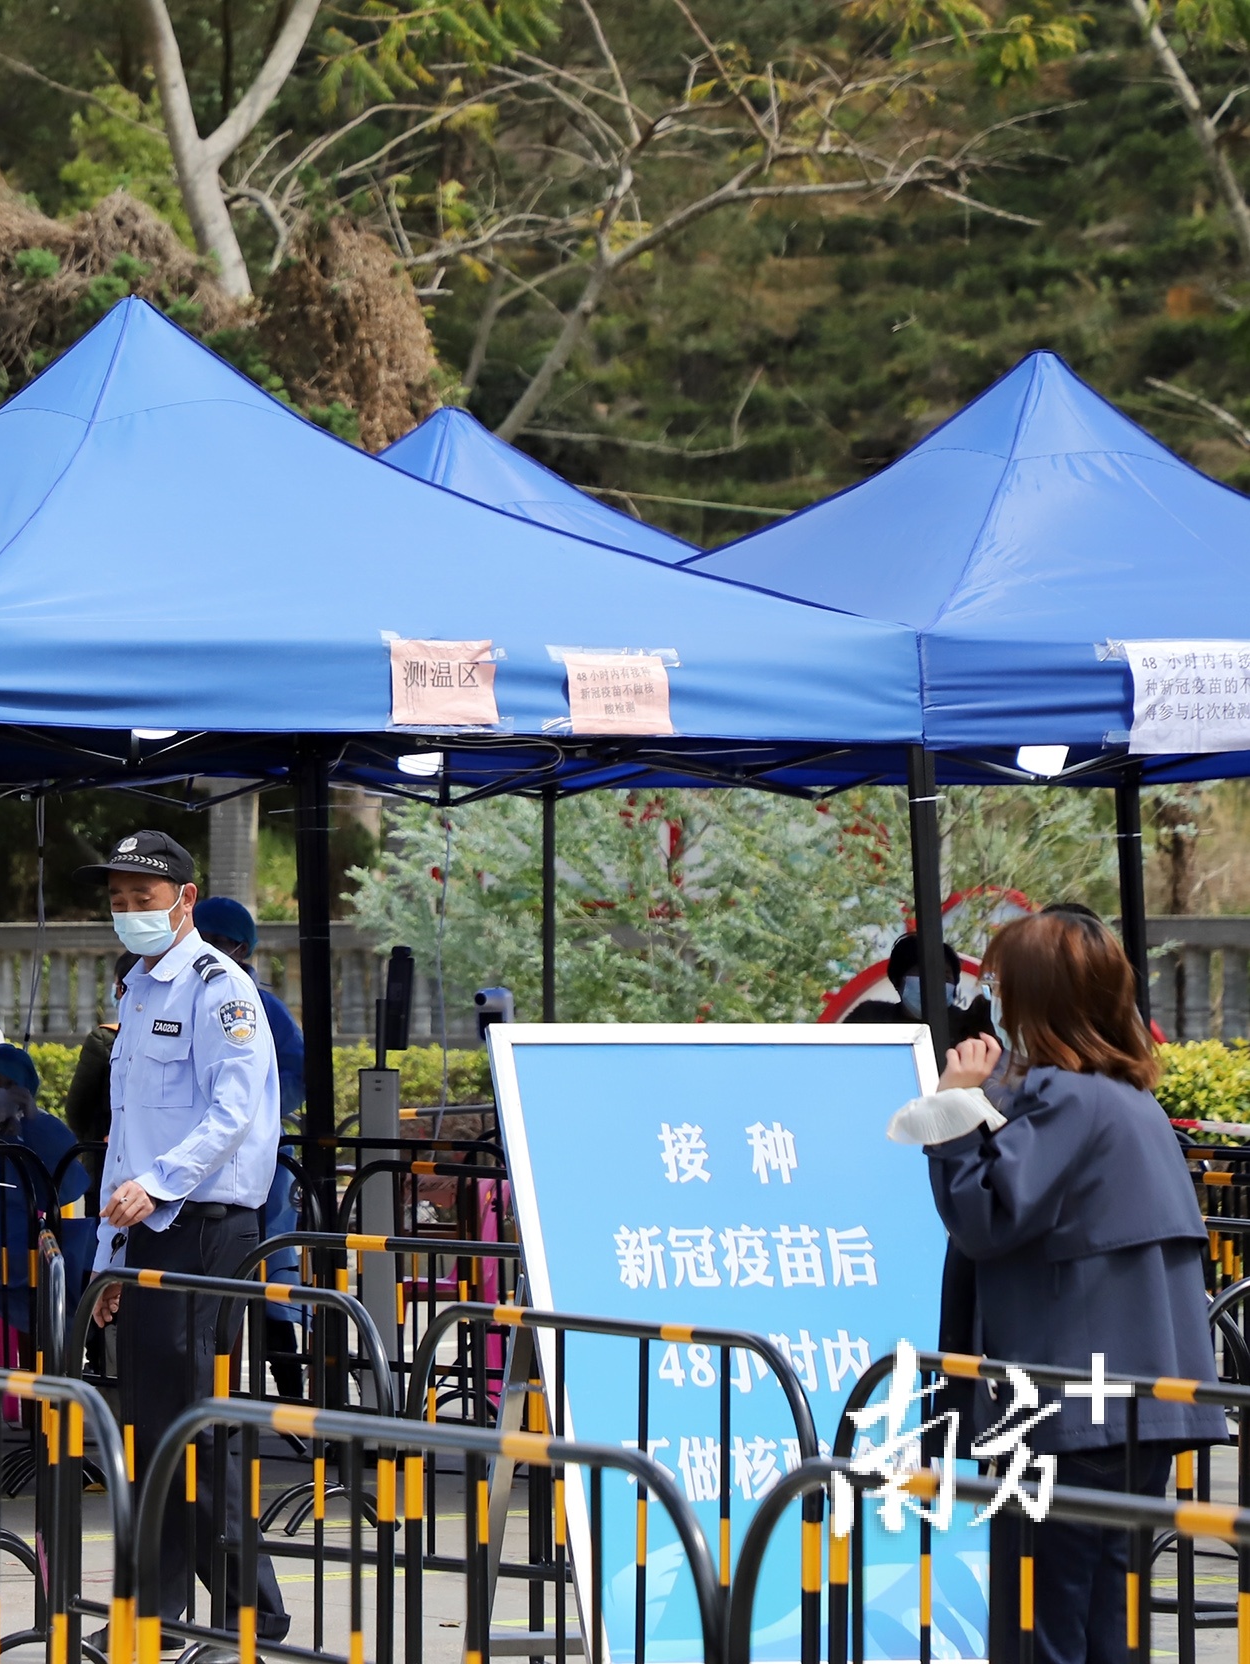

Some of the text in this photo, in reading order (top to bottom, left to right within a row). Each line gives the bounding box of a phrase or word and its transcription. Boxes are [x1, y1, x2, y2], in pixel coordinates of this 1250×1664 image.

[403, 660, 479, 688] 测温区
[580, 683, 654, 699] 新冠疫苗不做核
[604, 701, 636, 715] 酸检测
[613, 1223, 878, 1290] 新冠疫苗后
